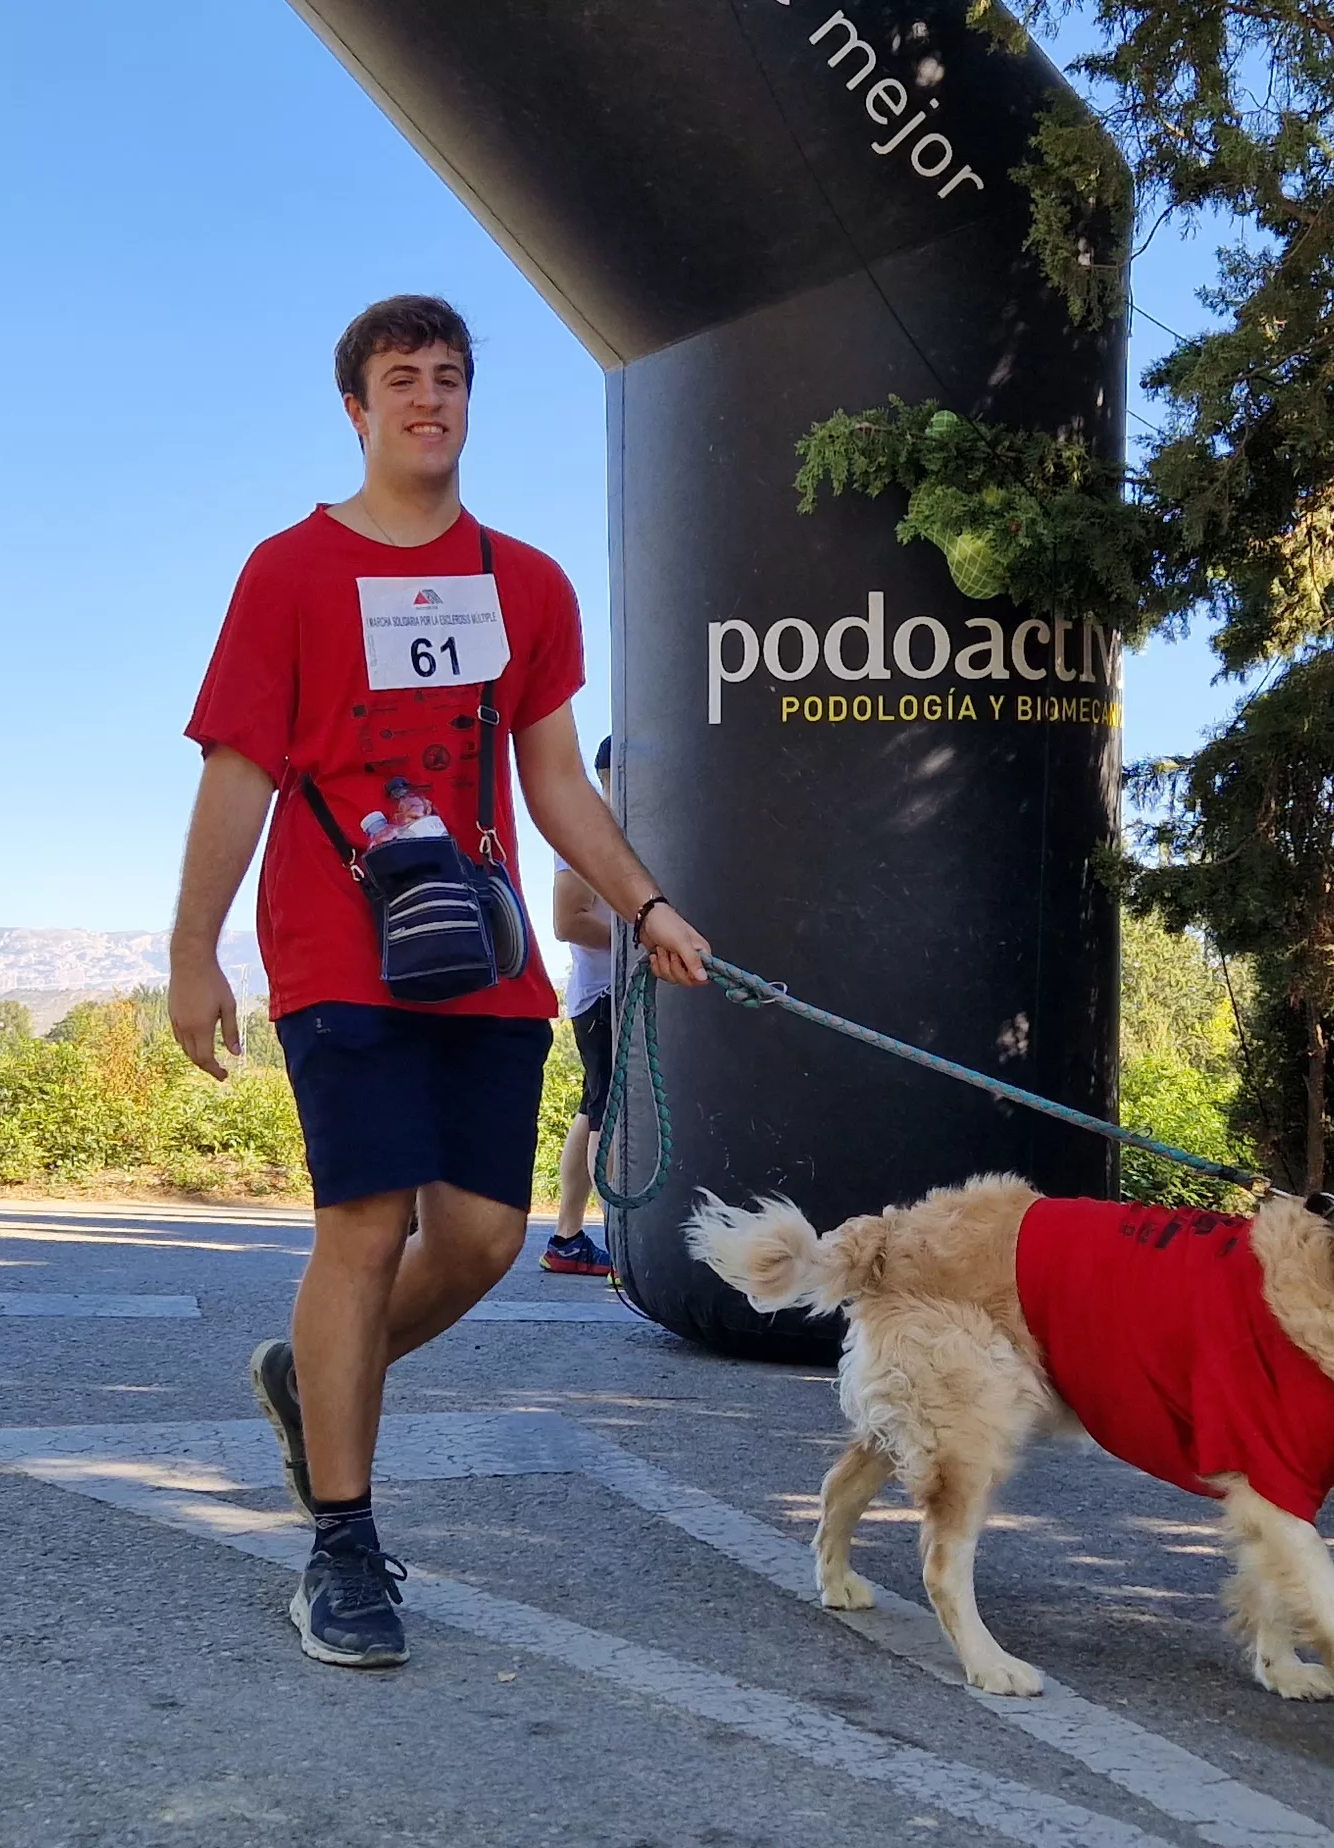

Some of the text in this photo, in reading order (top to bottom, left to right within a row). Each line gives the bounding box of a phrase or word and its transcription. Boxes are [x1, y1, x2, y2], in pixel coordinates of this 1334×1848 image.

[808, 9, 984, 199] mejor
[410, 636, 460, 678] 61
[781, 687, 977, 722] PODOLOGÍA
[990, 695, 1005, 721] Y
